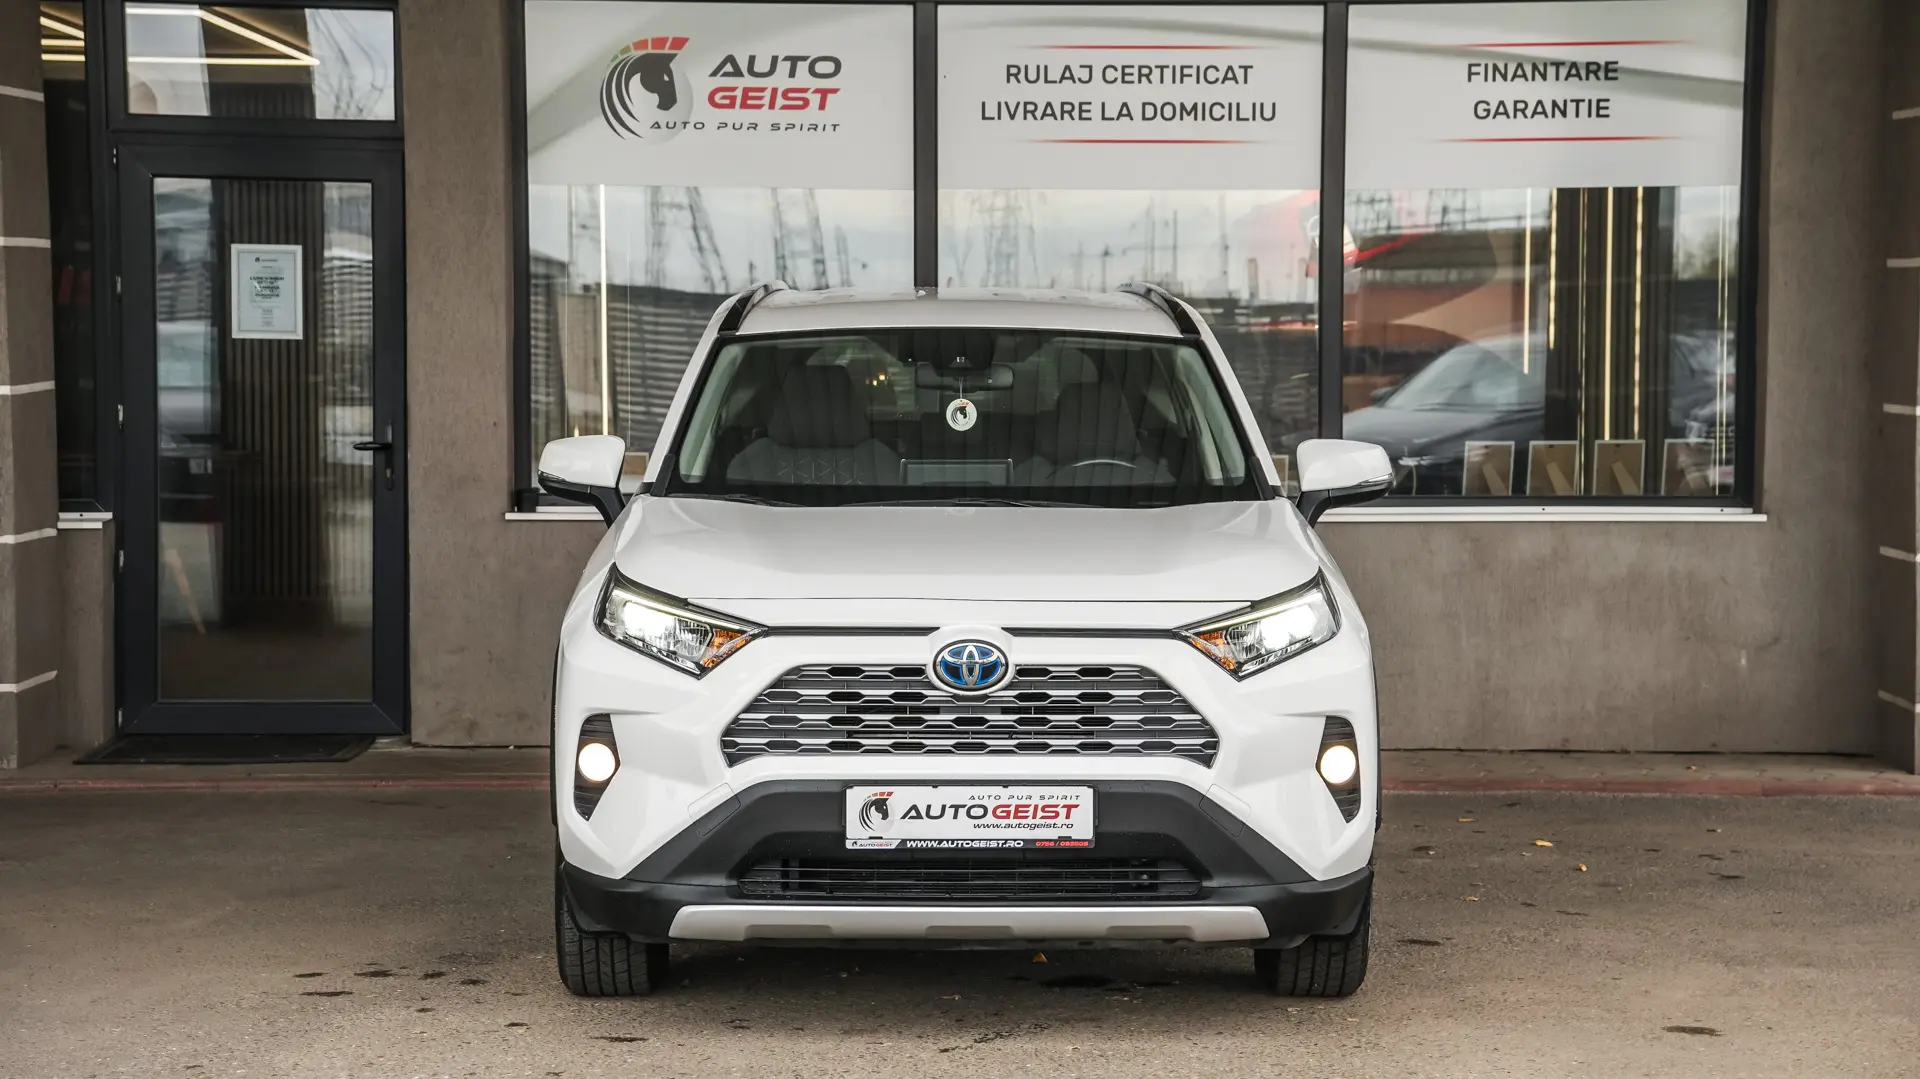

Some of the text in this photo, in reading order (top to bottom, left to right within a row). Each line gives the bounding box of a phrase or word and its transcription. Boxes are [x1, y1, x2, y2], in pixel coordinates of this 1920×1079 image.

[708, 54, 842, 79] AUTO
[1005, 64, 1254, 85] RULAJ CERTIFICAT
[1467, 60, 1619, 83] FINANTARE
[707, 86, 841, 111] GEIST
[1473, 98, 1611, 120] GARANTIE
[981, 101, 1277, 122] LIVRARE LA DOMICILIU
[649, 121, 841, 132] AUTO PUR SPIRIT
[900, 804, 1080, 820] AUTOGEIST
[973, 822, 1074, 831] www.autogeist.ro
[906, 840, 1024, 848] WWW.AUTOGEIST.RO
